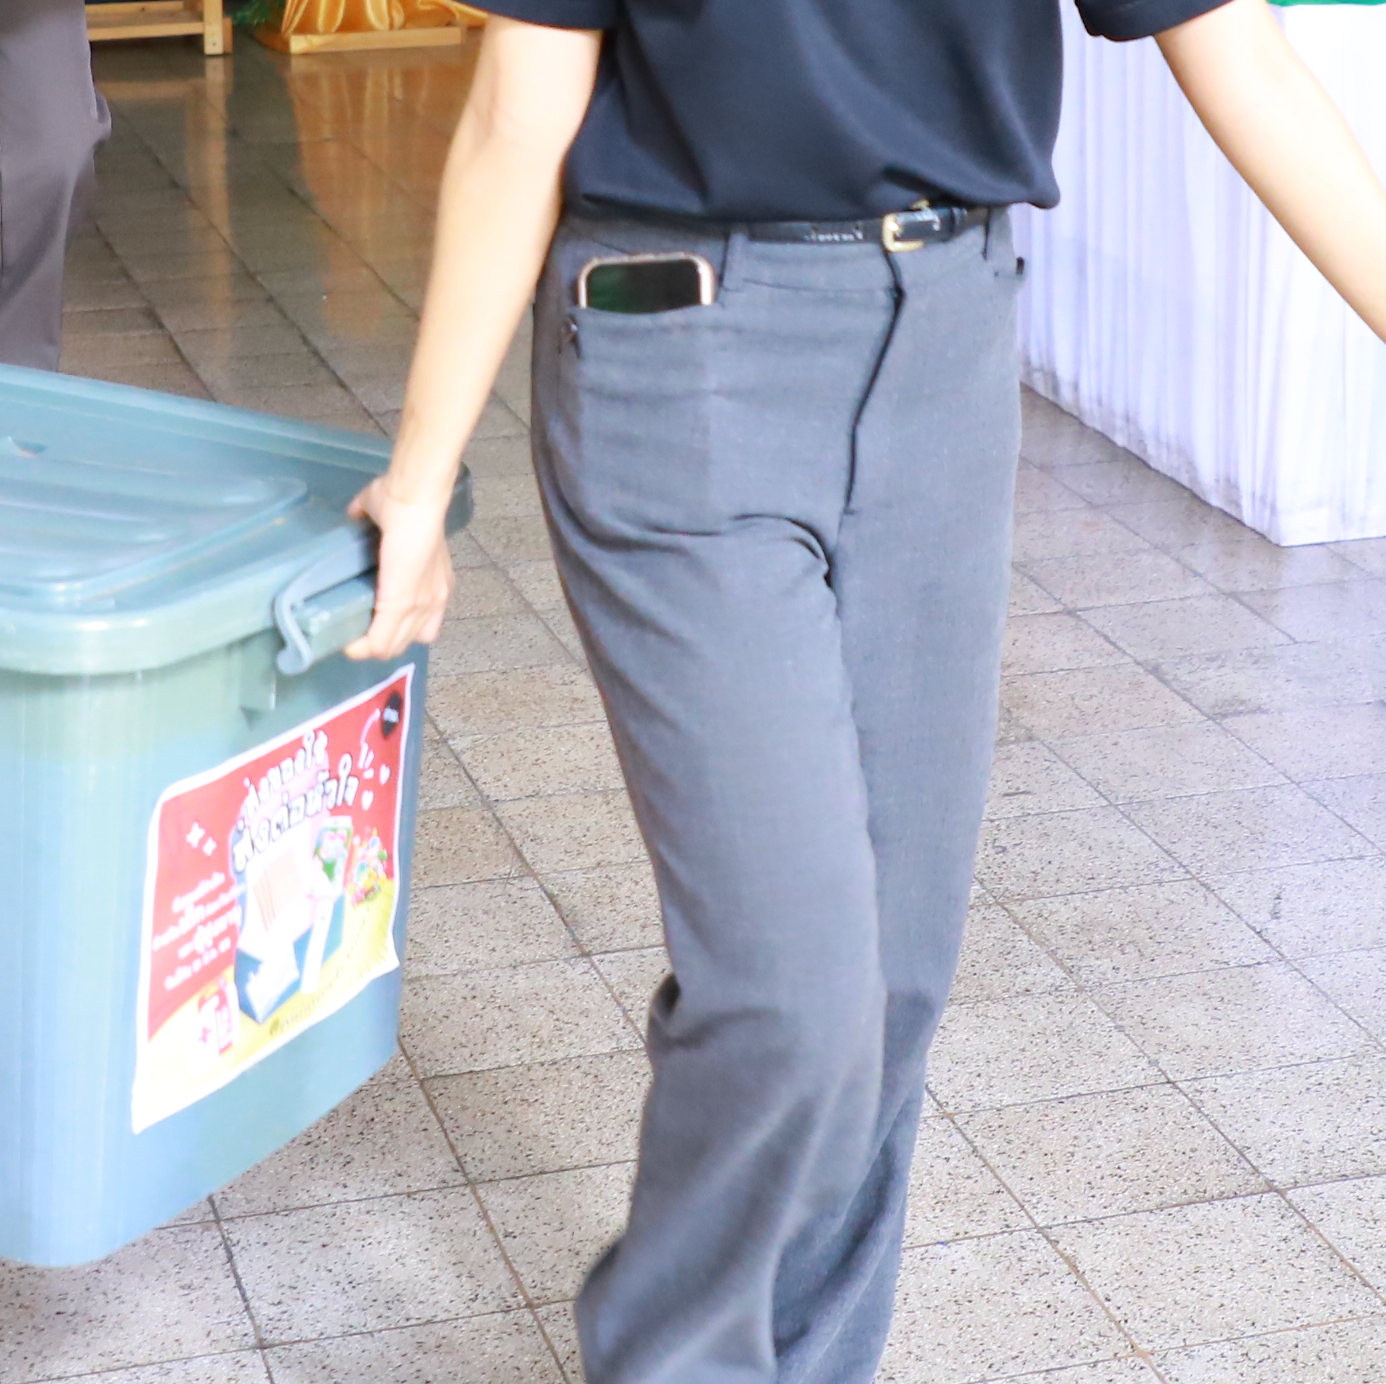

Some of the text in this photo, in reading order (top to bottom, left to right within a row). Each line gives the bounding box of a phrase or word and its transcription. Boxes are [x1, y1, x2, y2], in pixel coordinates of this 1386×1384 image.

[232, 754, 359, 872] ส่งต่อหัวใจ
